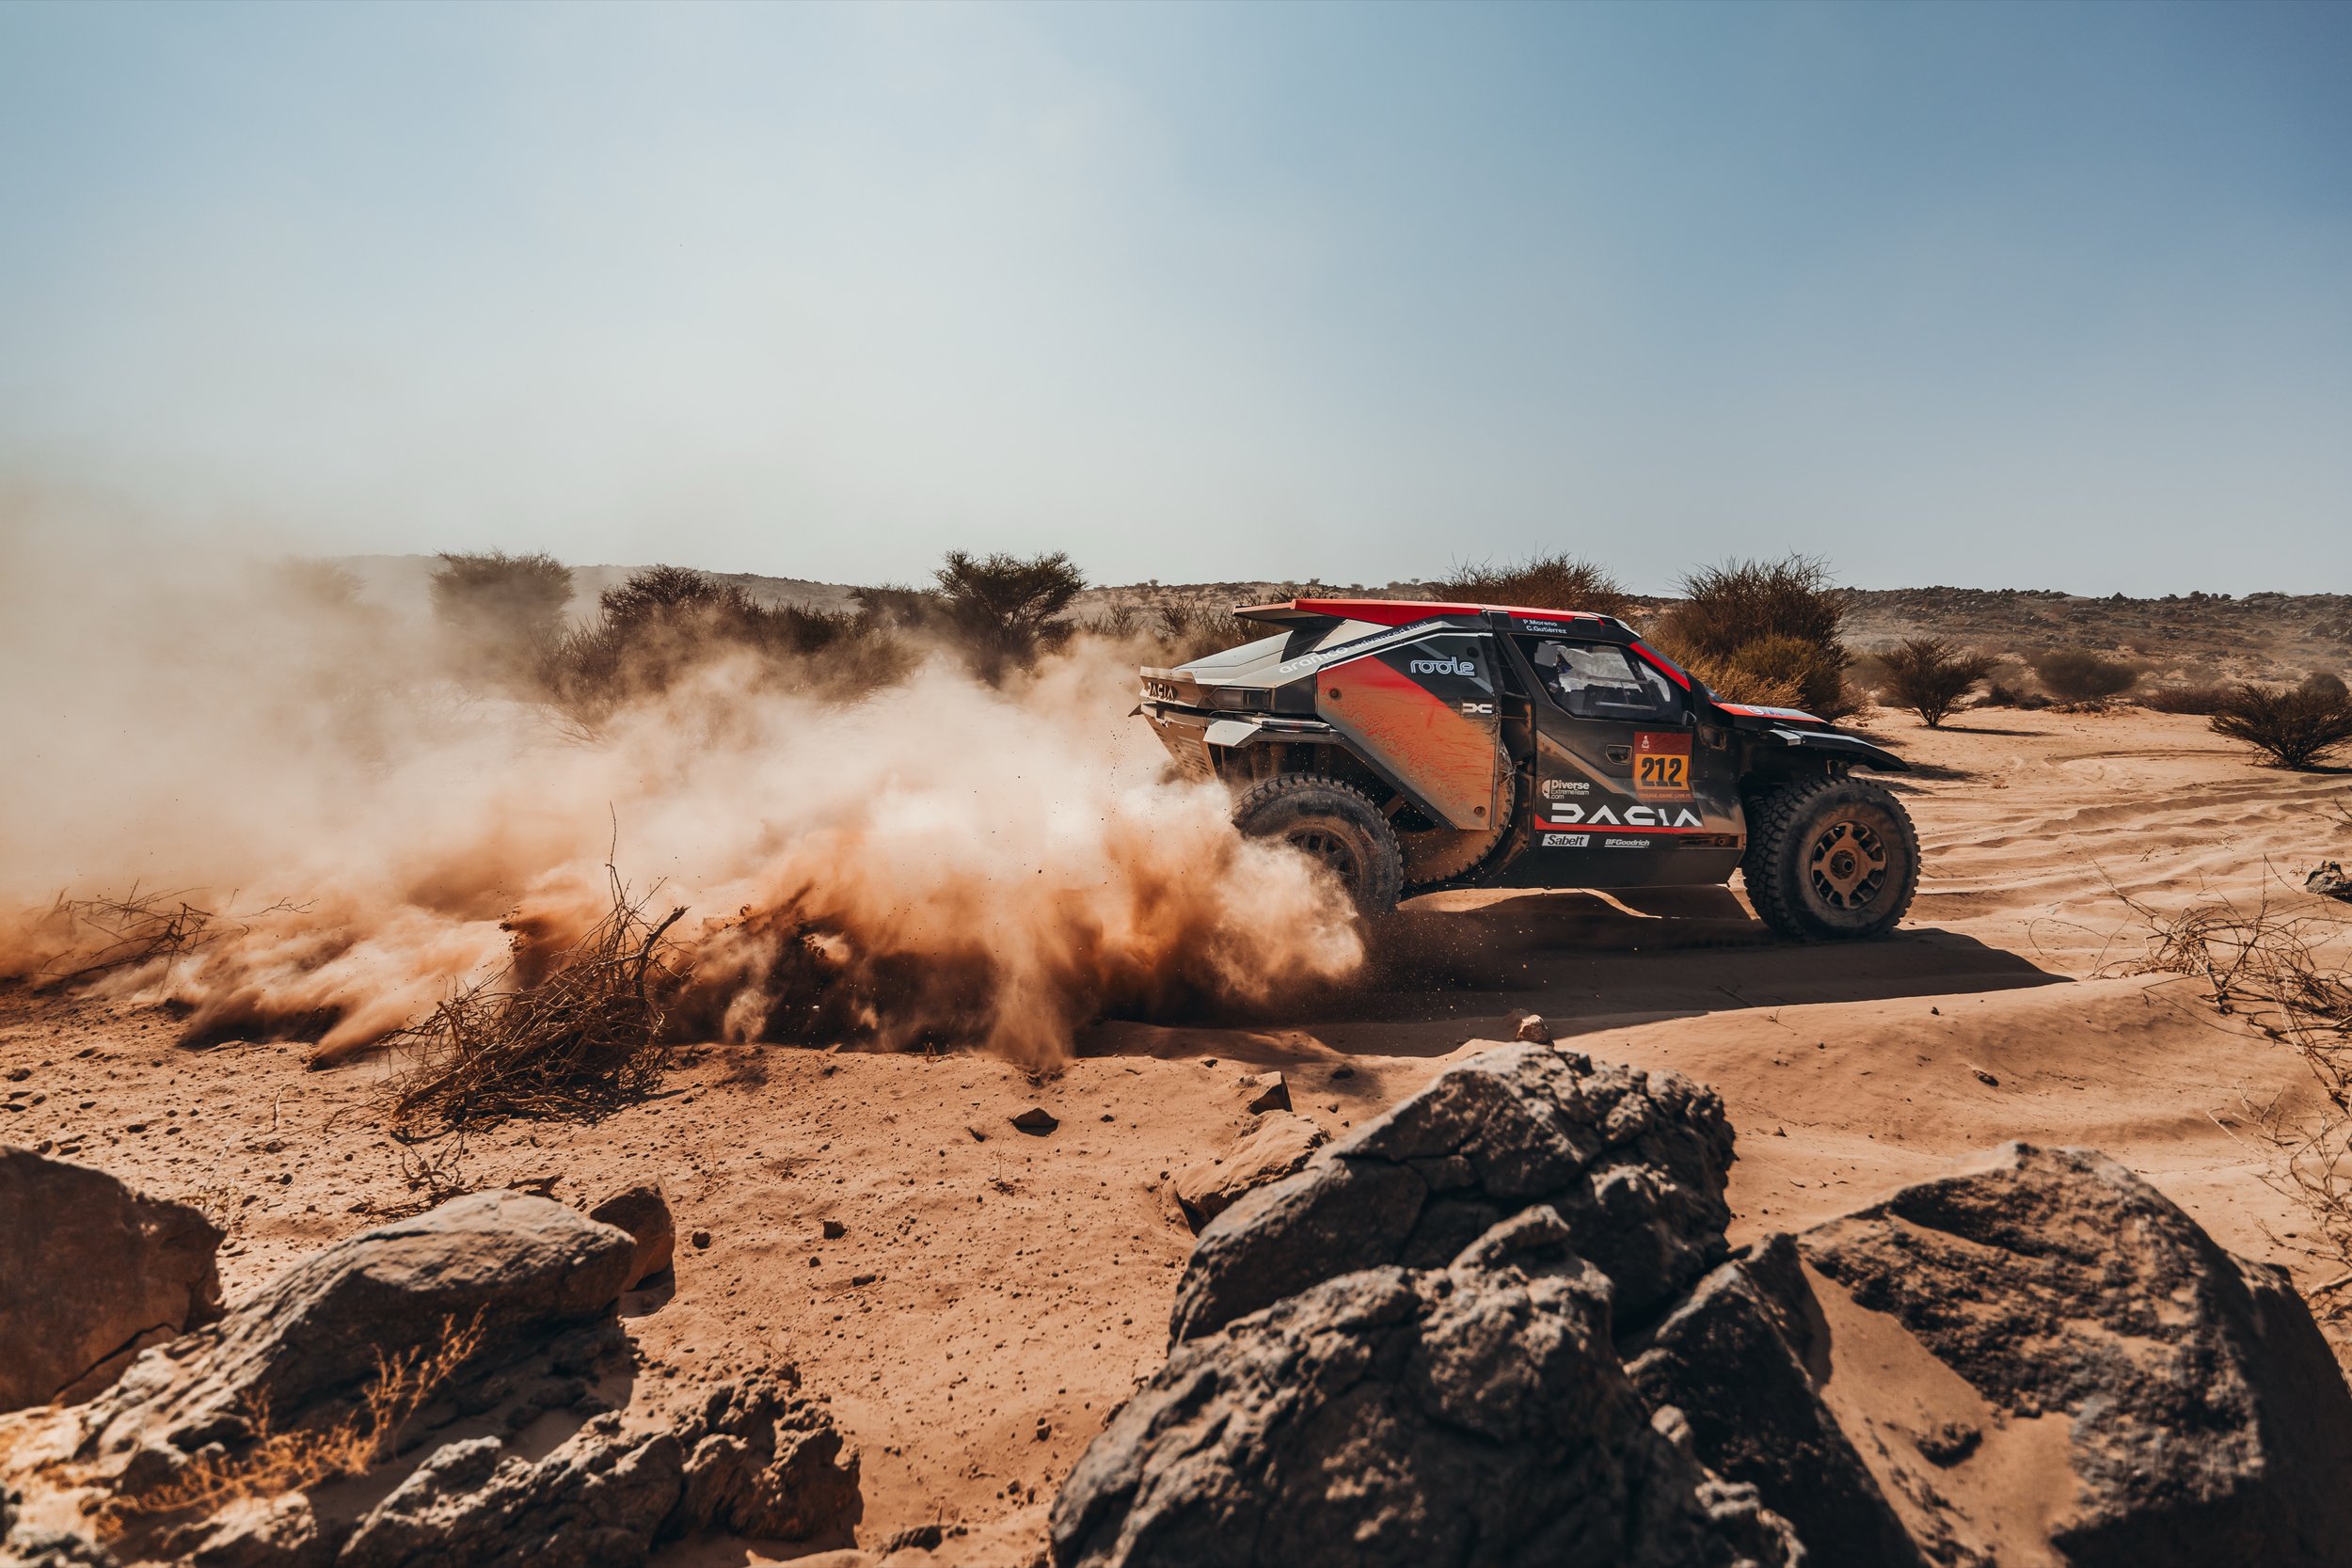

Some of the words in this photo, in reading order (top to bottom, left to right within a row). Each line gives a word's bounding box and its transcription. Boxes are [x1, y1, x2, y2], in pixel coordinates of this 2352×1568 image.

[1279, 645, 1349, 673] aramco
[1355, 628, 1406, 648] advanced
[1407, 621, 1429, 632] fuel
[1410, 656, 1475, 676] roole
[1641, 757, 1682, 786] 212
[1551, 780, 1590, 790] Diverse
[1550, 802, 1703, 828] DACIA
[1547, 835, 1585, 847] Sabelt
[1604, 838, 1650, 847] BFGoodrich
